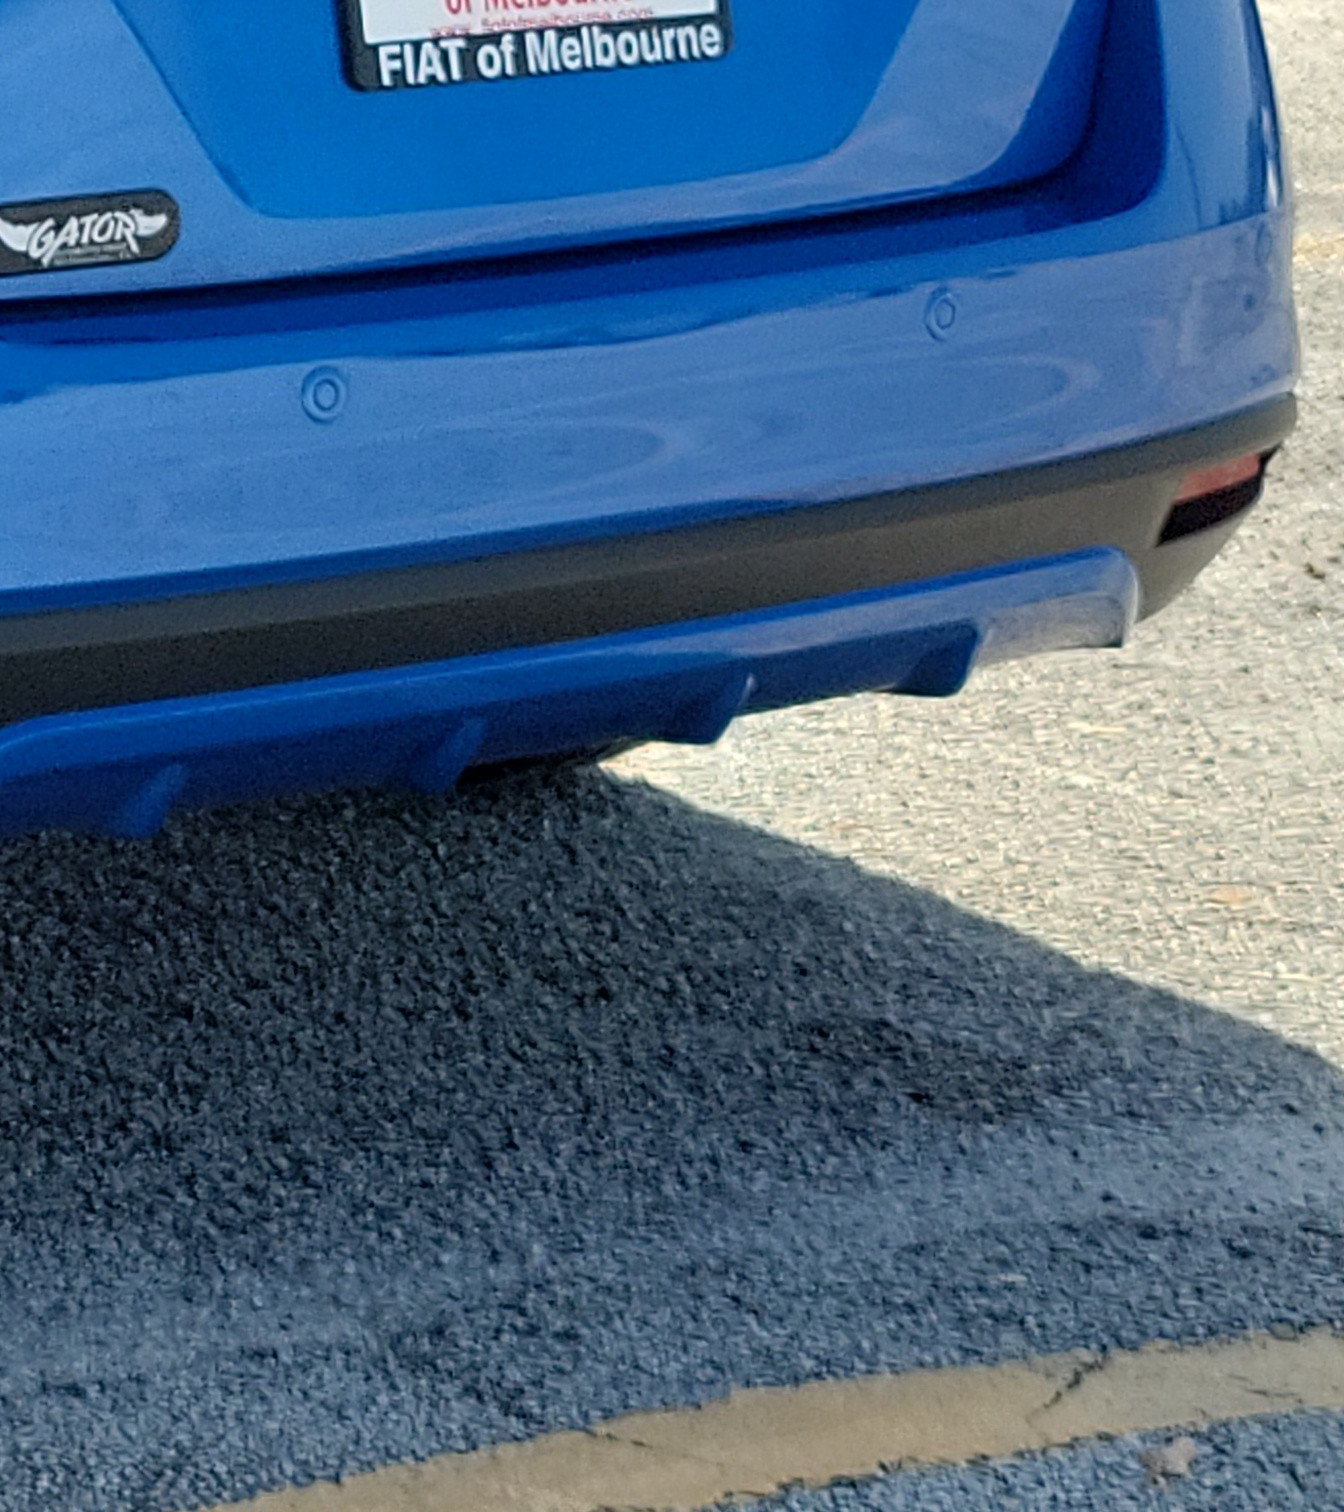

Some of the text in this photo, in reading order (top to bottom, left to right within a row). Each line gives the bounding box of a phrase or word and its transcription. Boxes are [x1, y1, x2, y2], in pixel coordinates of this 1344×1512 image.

[377, 39, 466, 87] FIAT
[476, 32, 516, 79] of
[524, 21, 723, 75] Melbourne
[27, 210, 141, 268] GATOR
